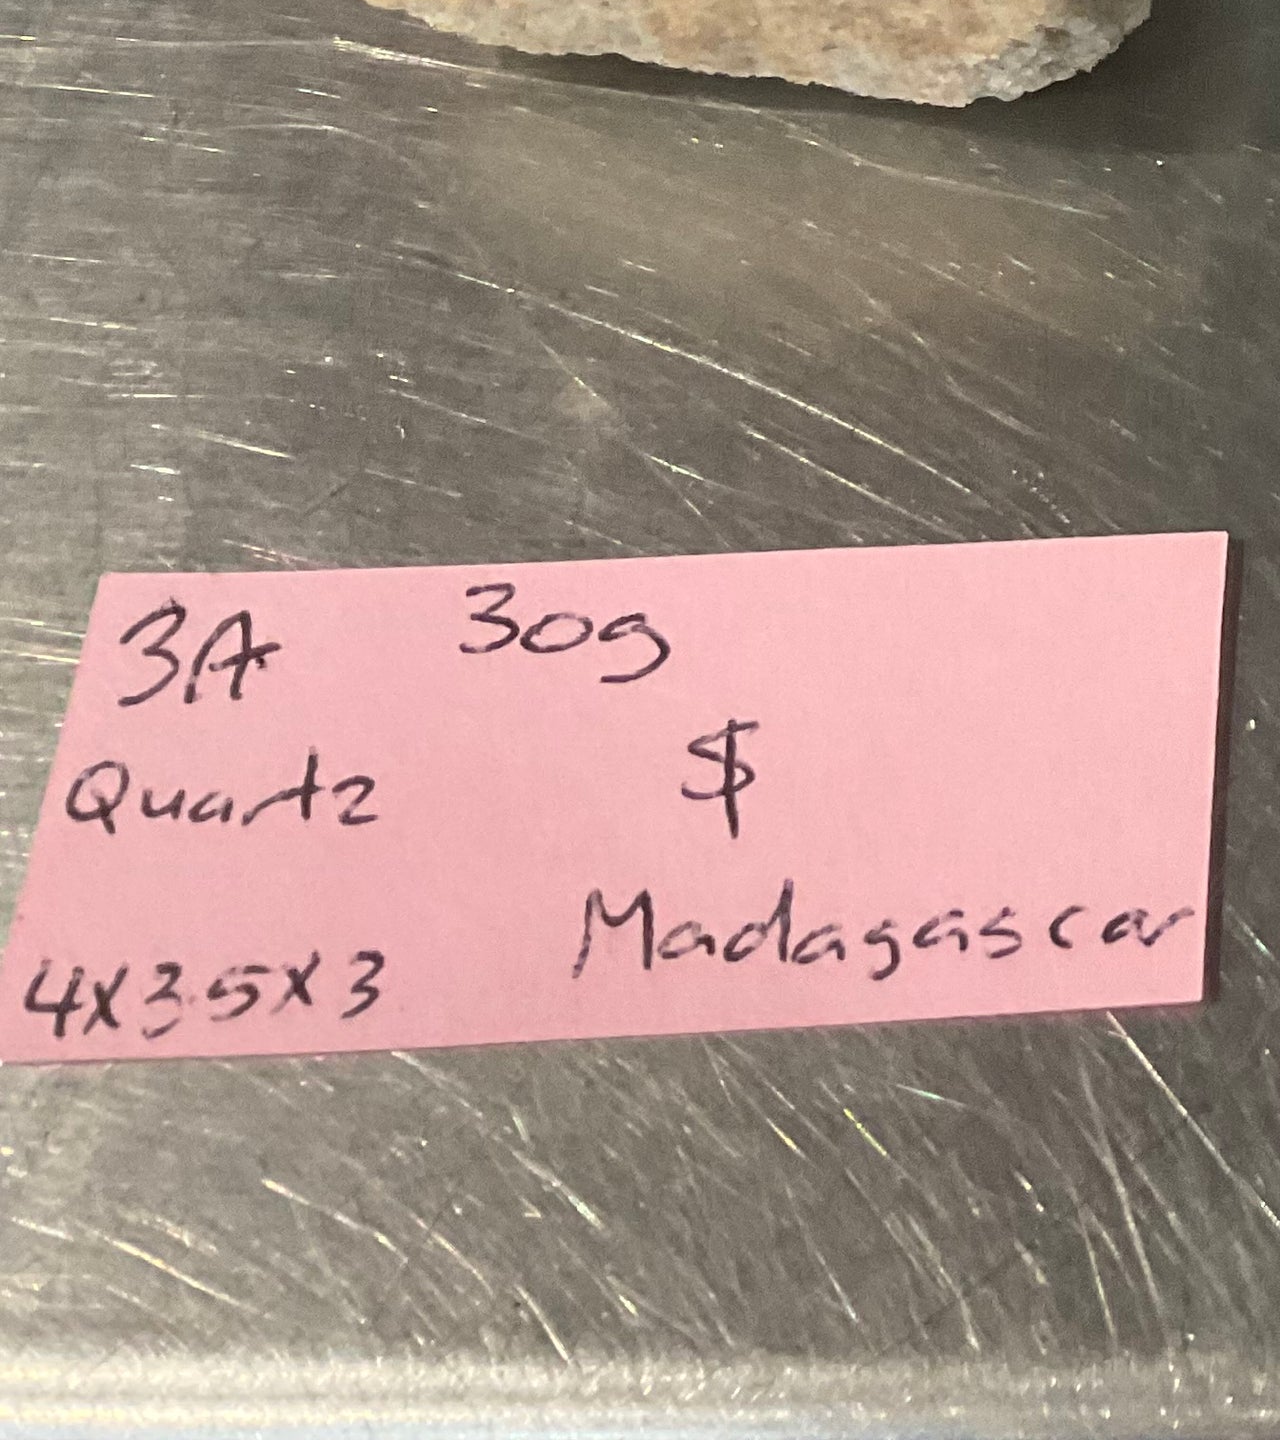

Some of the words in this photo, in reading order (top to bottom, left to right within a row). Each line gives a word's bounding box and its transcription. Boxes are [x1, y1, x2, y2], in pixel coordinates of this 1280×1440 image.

[120, 598, 284, 709] 3A
[458, 581, 673, 684] 30g
[64, 749, 380, 837] Quartz
[679, 716, 761, 840] $
[570, 877, 1197, 983] Madagascar
